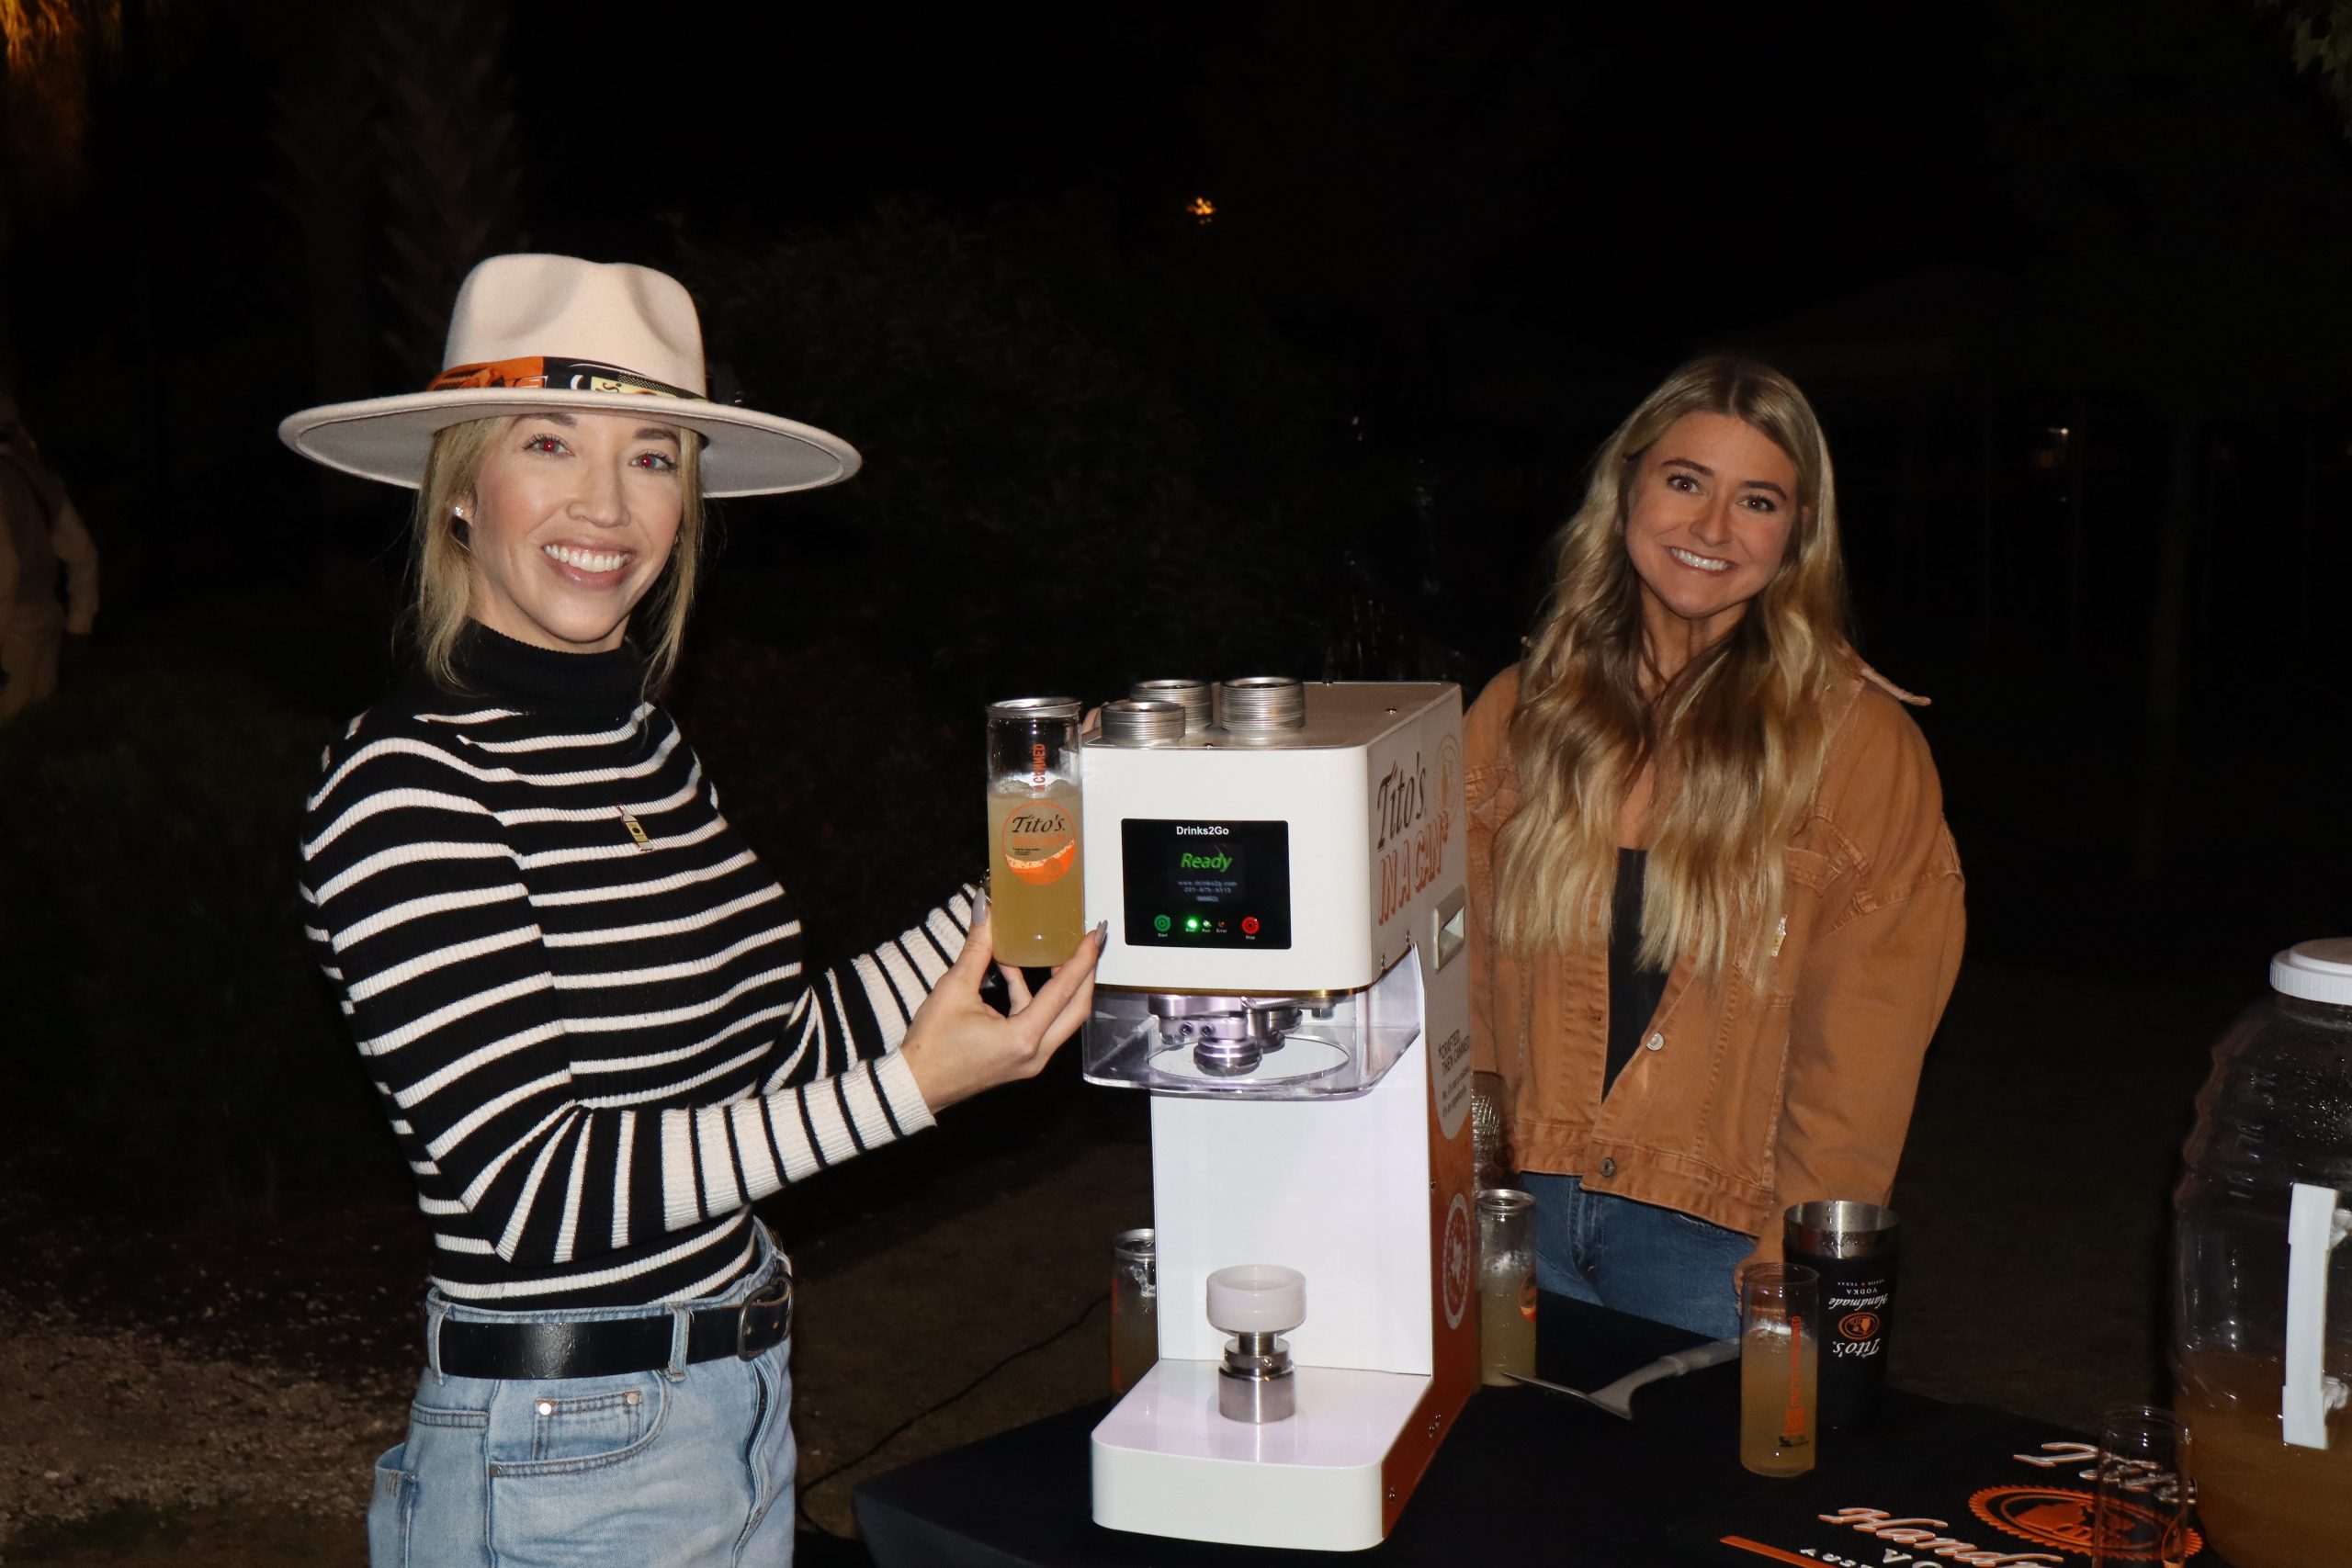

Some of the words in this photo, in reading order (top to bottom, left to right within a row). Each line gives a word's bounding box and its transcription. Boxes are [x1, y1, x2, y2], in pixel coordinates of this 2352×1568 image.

[1377, 750, 1426, 852] Tito's
[1012, 813, 1064, 833] Tito's
[1176, 826, 1229, 836] Drinks2Go
[1181, 852, 1233, 873] Ready
[1846, 1287, 1878, 1295] VODKA
[1827, 1293, 1889, 1311] Handmade
[1832, 1337, 1881, 1359] Tito's
